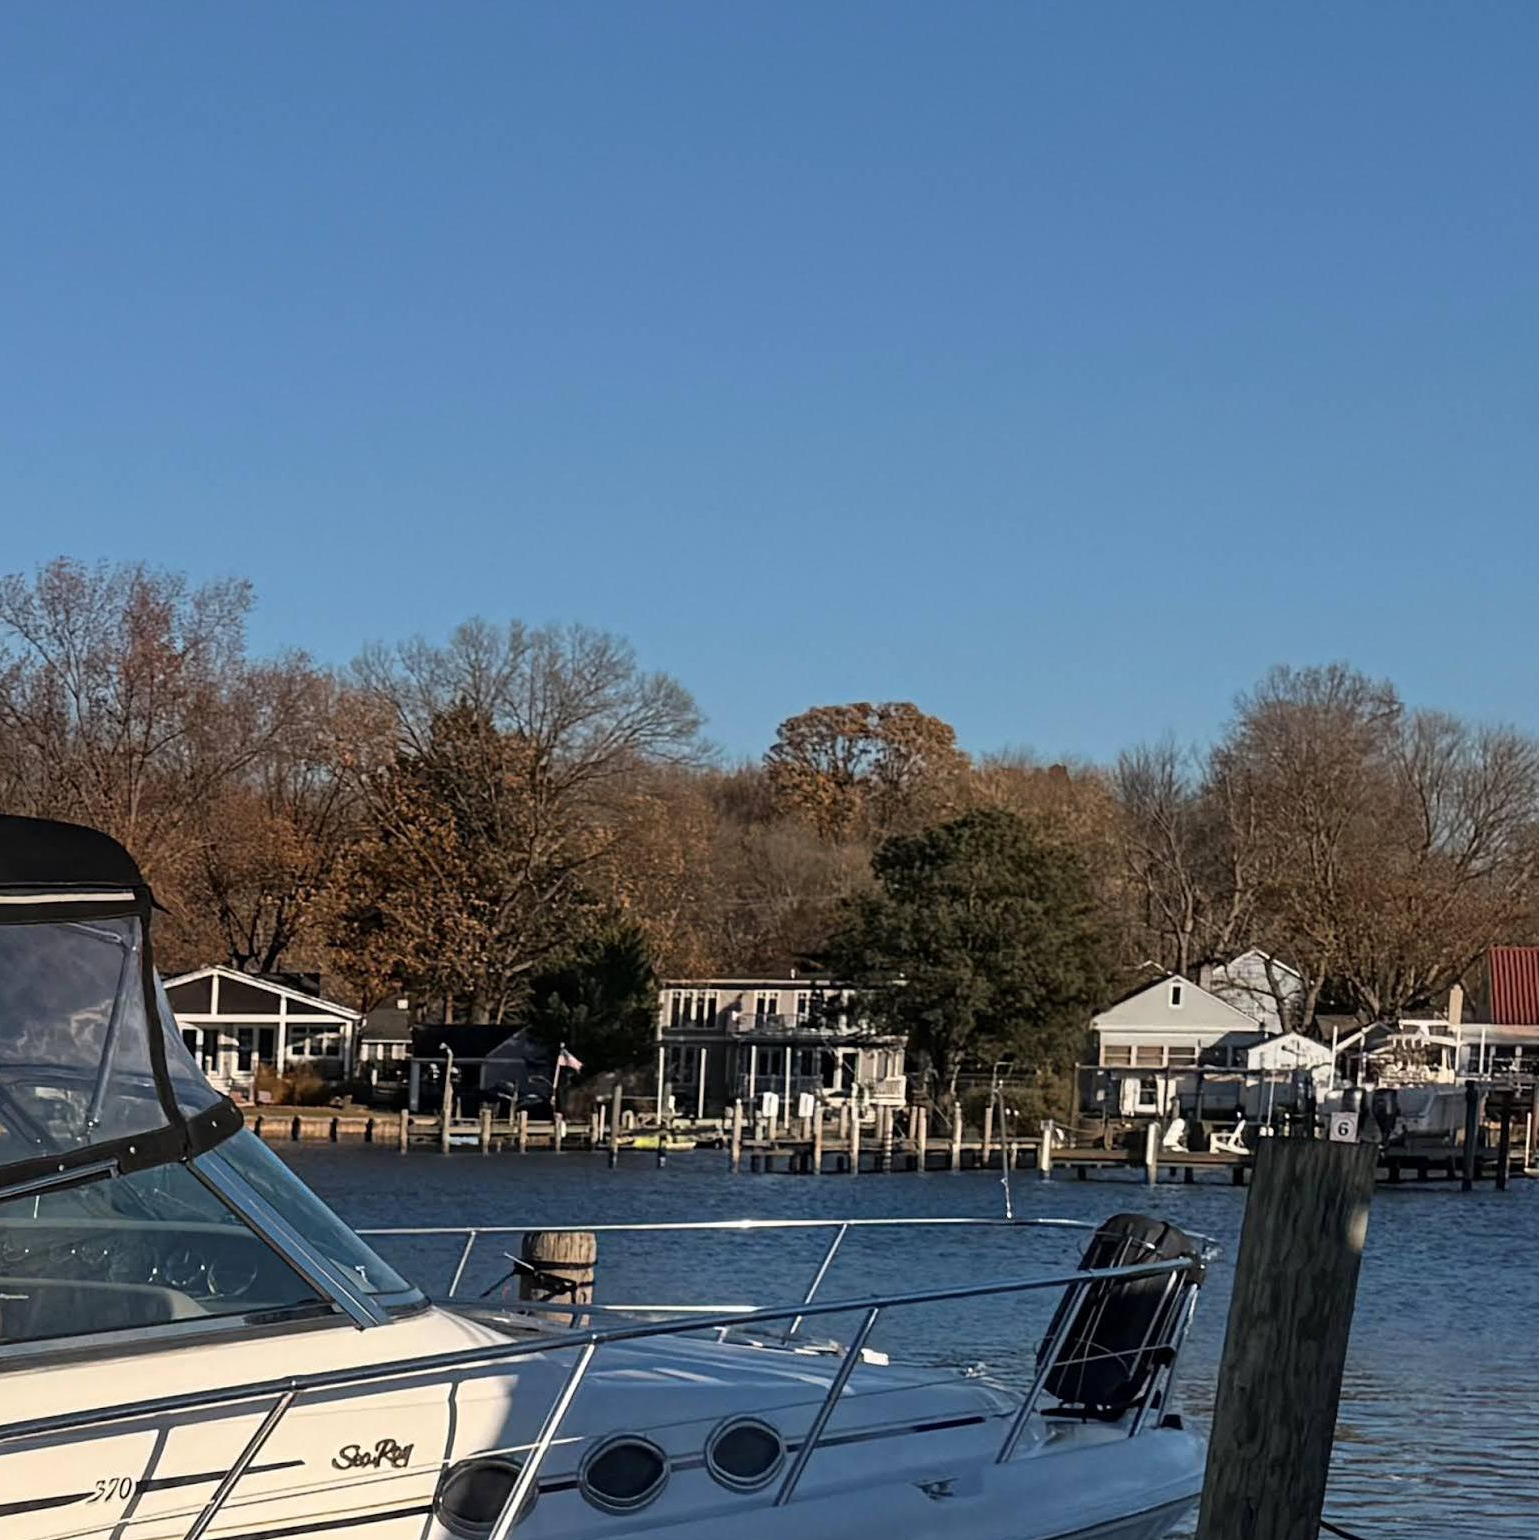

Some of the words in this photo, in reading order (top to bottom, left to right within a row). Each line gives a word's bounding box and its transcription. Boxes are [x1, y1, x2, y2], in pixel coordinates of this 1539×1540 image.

[1338, 1121, 1349, 1137] 6
[331, 1444, 374, 1470] Sea
[374, 1438, 414, 1469] Ray
[86, 1476, 133, 1504] 370
